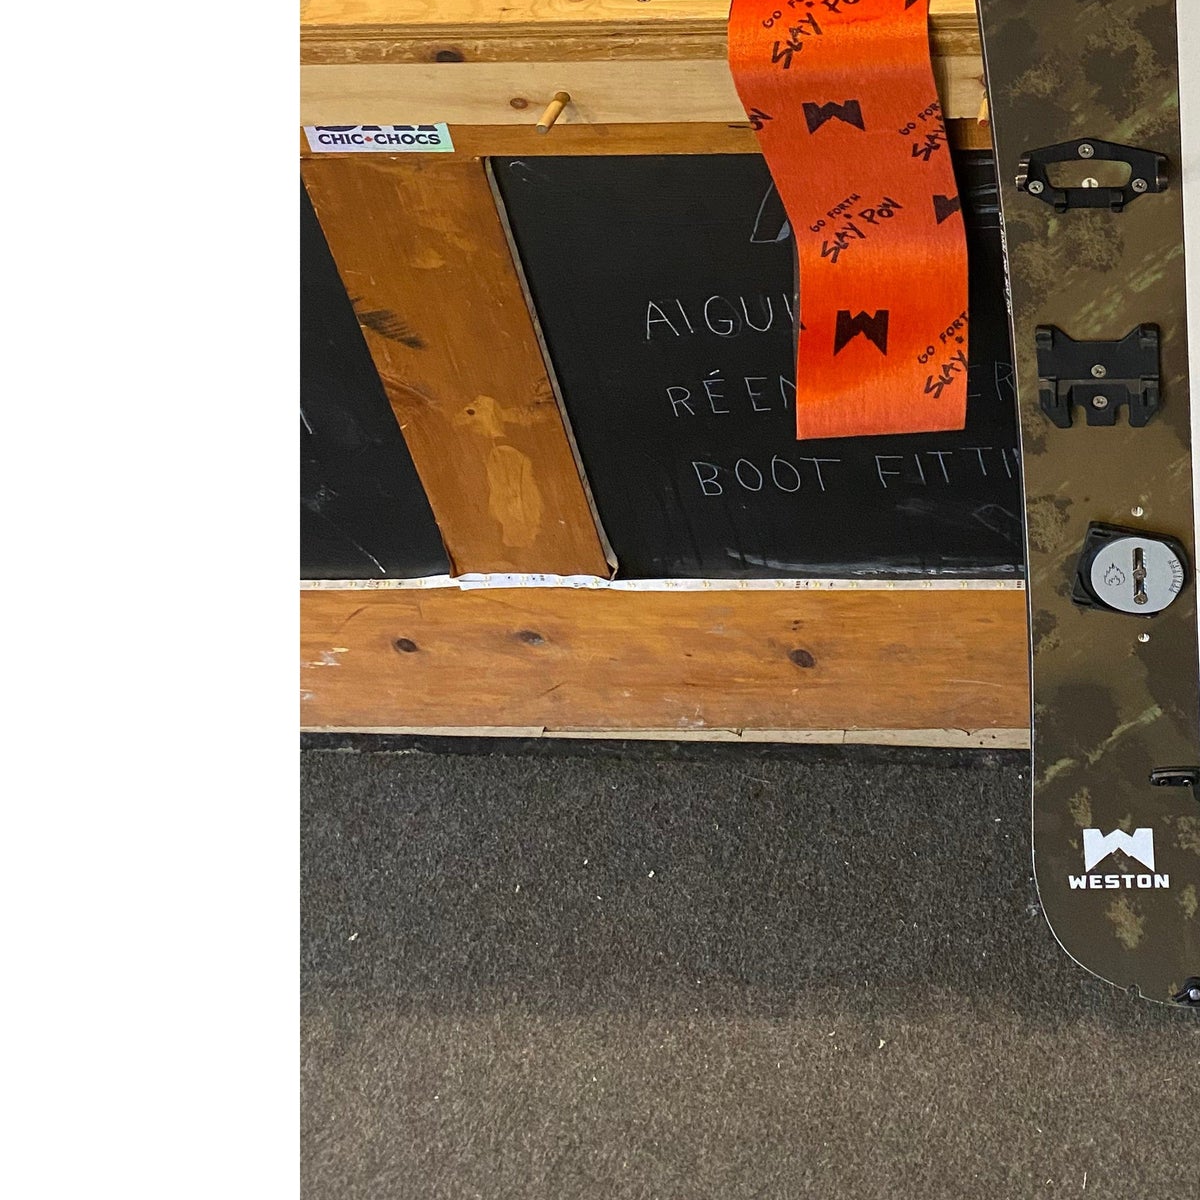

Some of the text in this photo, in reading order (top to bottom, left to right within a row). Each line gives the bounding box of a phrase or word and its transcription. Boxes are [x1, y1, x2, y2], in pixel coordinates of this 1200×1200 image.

[762, 10, 782, 29] GO
[771, 12, 822, 69] SLAY
[318, 133, 441, 145] CHIC CHOCS
[898, 122, 917, 136] GO
[809, 193, 861, 233] GO FORTH
[820, 196, 904, 264] SLAY POW
[917, 345, 935, 365] GO
[923, 349, 968, 399] SLAY
[692, 455, 841, 496] BOOT
[1068, 874, 1170, 890] WESTON
